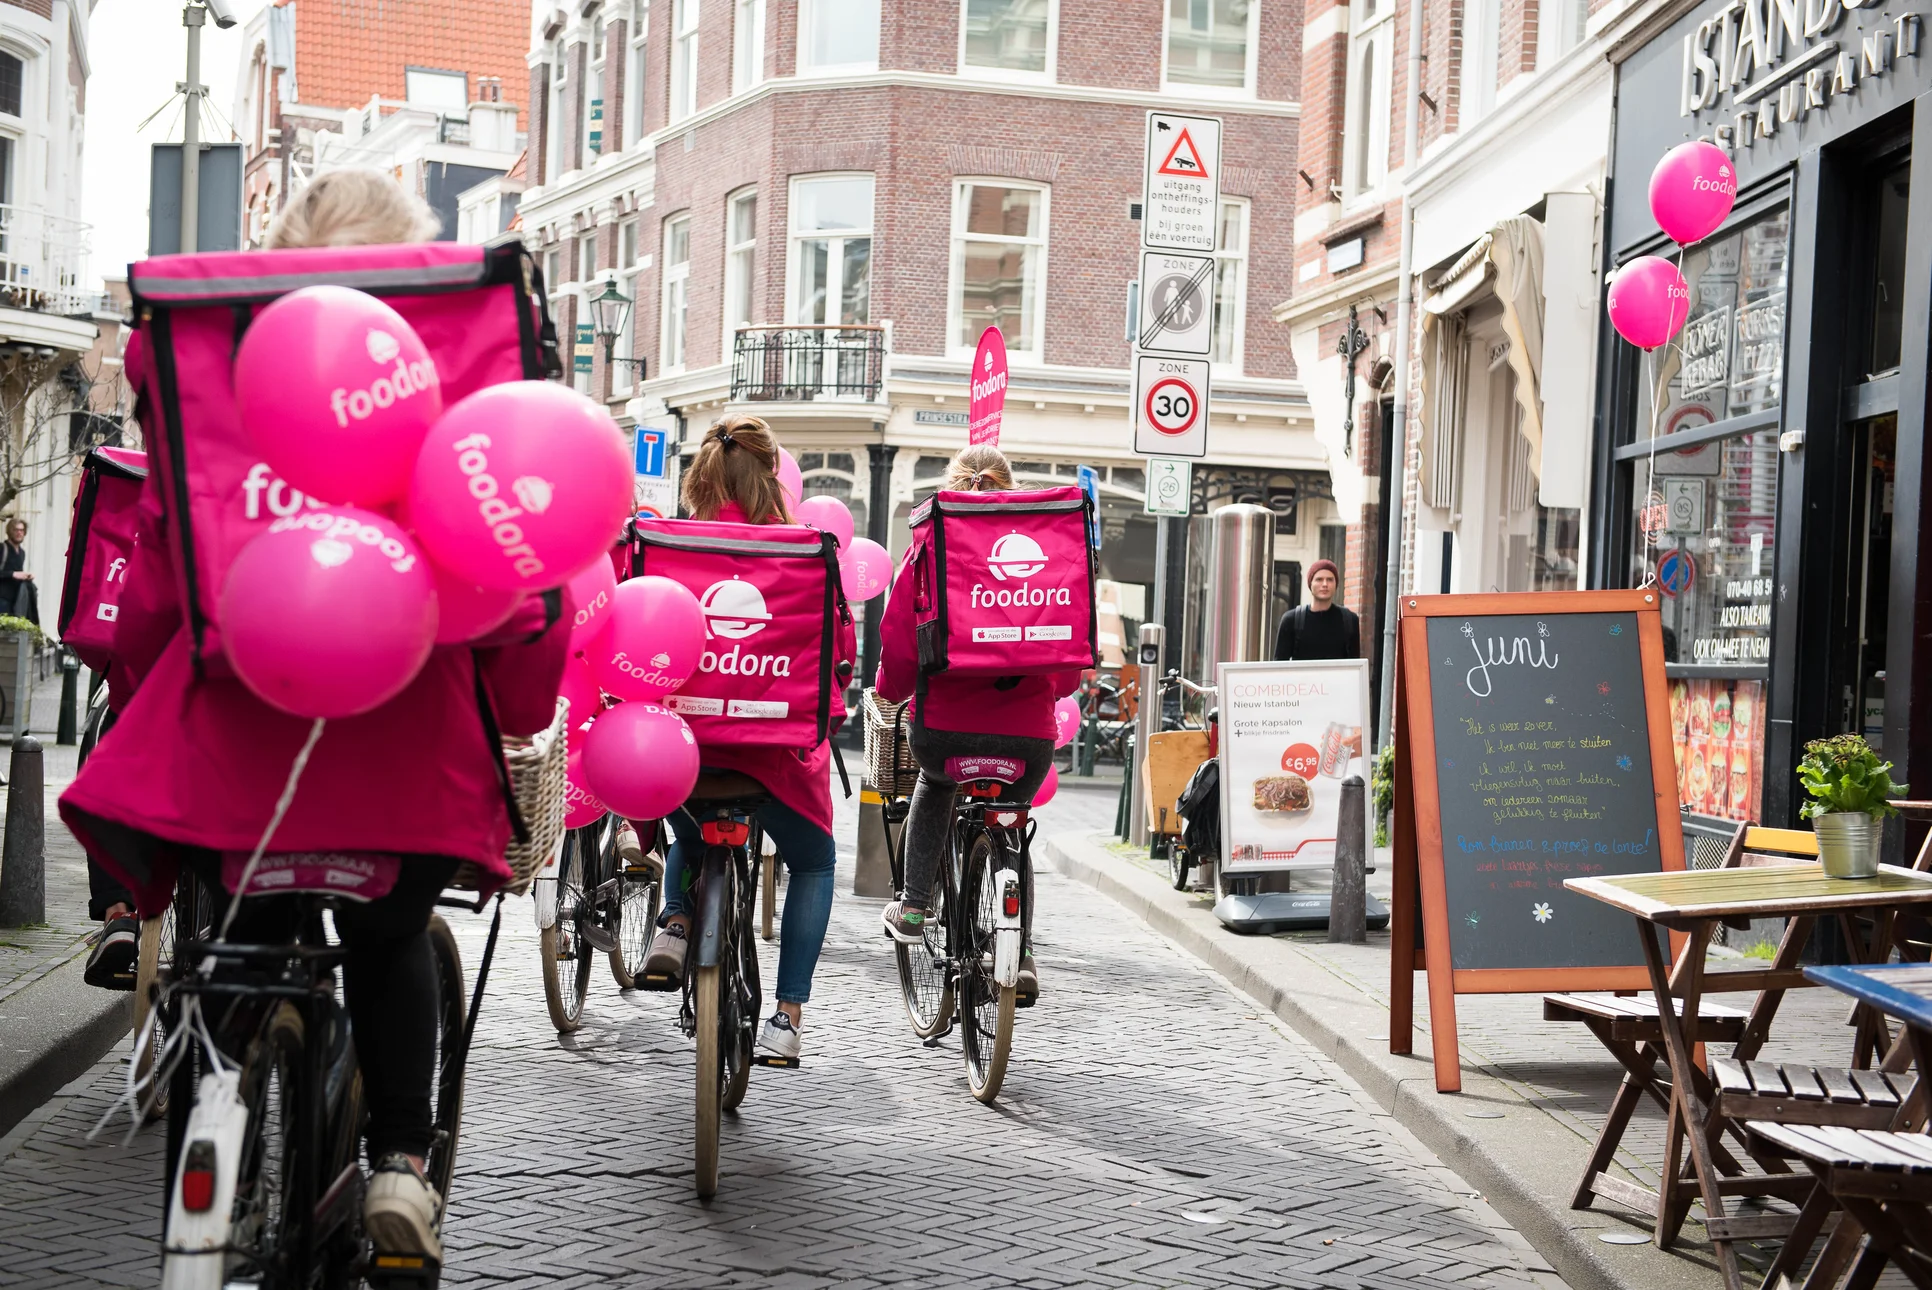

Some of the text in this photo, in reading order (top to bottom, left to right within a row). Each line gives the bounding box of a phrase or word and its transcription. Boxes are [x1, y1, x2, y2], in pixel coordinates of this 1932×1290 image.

[1697, 12, 1919, 152] STAURANT
[1164, 180, 1201, 193] uitgang
[1693, 176, 1736, 196] foodor
[1151, 191, 1212, 204] ontheffings-
[1161, 203, 1201, 215] houders
[1159, 220, 1203, 232] bij groen
[1170, 233, 1212, 246] voertuig
[1163, 259, 1195, 271] ZONE
[1158, 362, 1189, 374] ZONE
[330, 356, 440, 428] foodor
[972, 371, 1006, 403] foodora
[1155, 394, 1190, 418] 30
[919, 411, 970, 424] PRINSESTRA
[1162, 481, 1176, 492] 26
[452, 432, 546, 580] foodora
[856, 560, 869, 597] foodo
[970, 582, 1072, 609] foodora
[1726, 581, 1752, 598] 070-40
[1753, 579, 1764, 596] 68
[1719, 604, 1771, 628] ALSO TAKEAW
[1693, 638, 1710, 659] OOK
[1741, 637, 1749, 657] TE
[1750, 637, 1770, 657] NEM
[698, 644, 791, 677] odora
[1467, 636, 1558, 697] juni
[611, 652, 685, 688] foodora
[1233, 683, 1329, 698] COMBIDEAL
[680, 703, 717, 712] App Store
[1233, 699, 1300, 709] Nieuw Istanbul
[1233, 719, 1303, 728] Grote Kapsalon
[1489, 722, 1495, 732] is
[1244, 729, 1261, 737] blikje
[1262, 729, 1290, 737] frisdrank
[1484, 739, 1495, 754] Ik
[1498, 740, 1516, 752] ben
[1518, 740, 1539, 750] niet
[1567, 737, 1576, 748] te
[1579, 736, 1612, 749] stuiten
[1479, 760, 1493, 776] ik
[1524, 760, 1536, 773] ik
[1546, 777, 1572, 786] naar
[1483, 797, 1497, 807] om
[1501, 795, 1543, 806] iedereen
[1493, 807, 1545, 825] gelukkig
[1549, 808, 1558, 818] te
[1489, 835, 1536, 853] binnen
[1594, 840, 1608, 855] de
